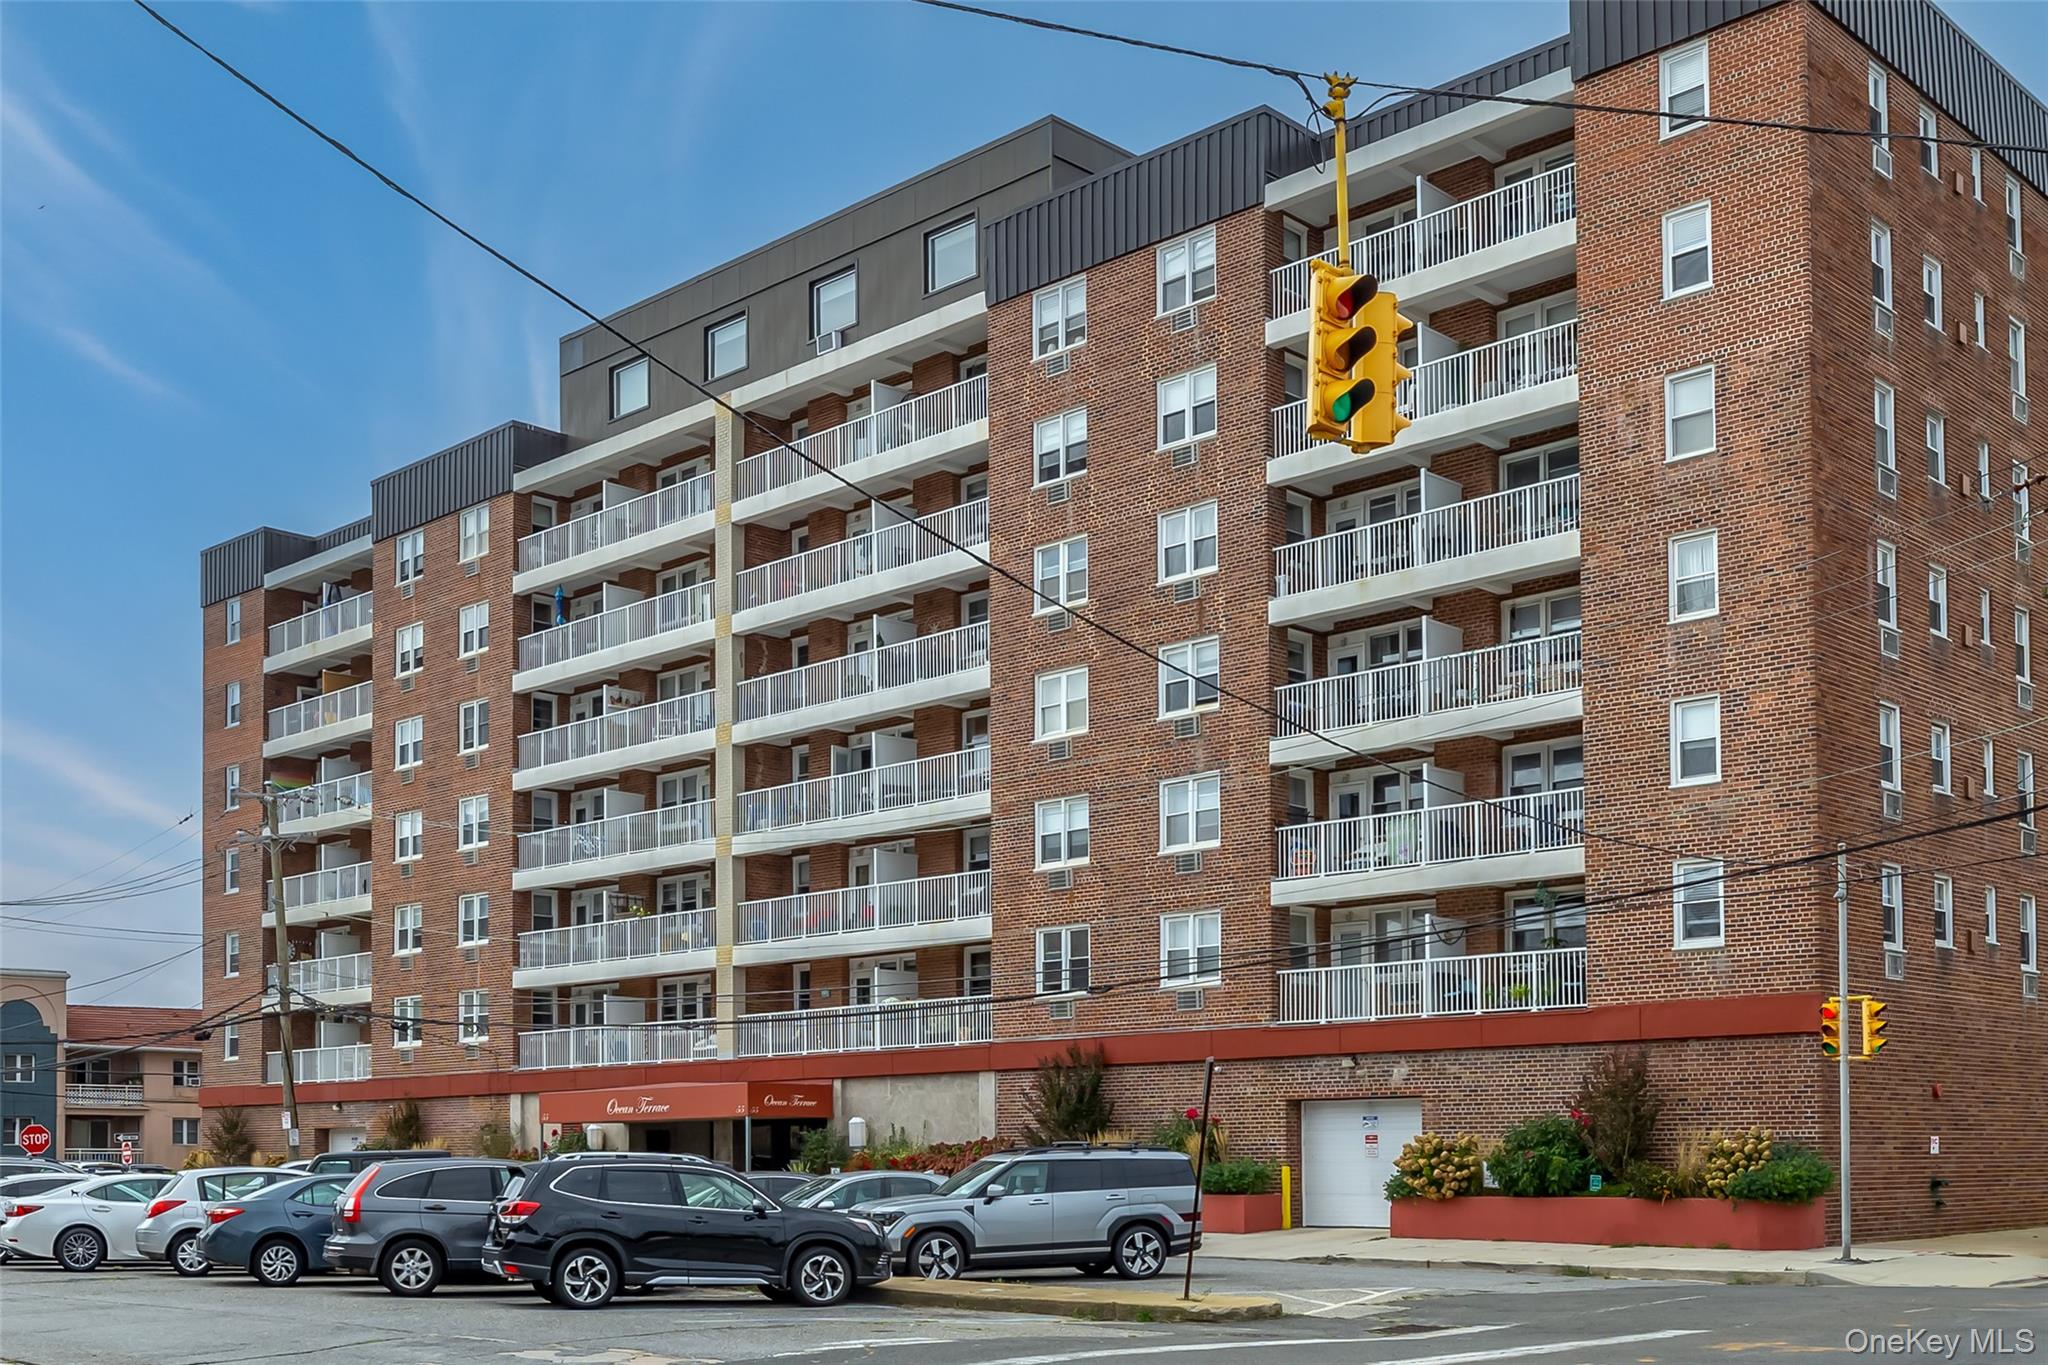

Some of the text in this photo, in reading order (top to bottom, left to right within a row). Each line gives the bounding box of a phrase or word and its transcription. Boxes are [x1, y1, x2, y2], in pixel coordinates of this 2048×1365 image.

[606, 1096, 670, 1115] Ocean Terrace
[763, 1094, 817, 1107] Ocean Terrace
[735, 1104, 745, 1114] 55
[22, 1133, 49, 1146] STOP
